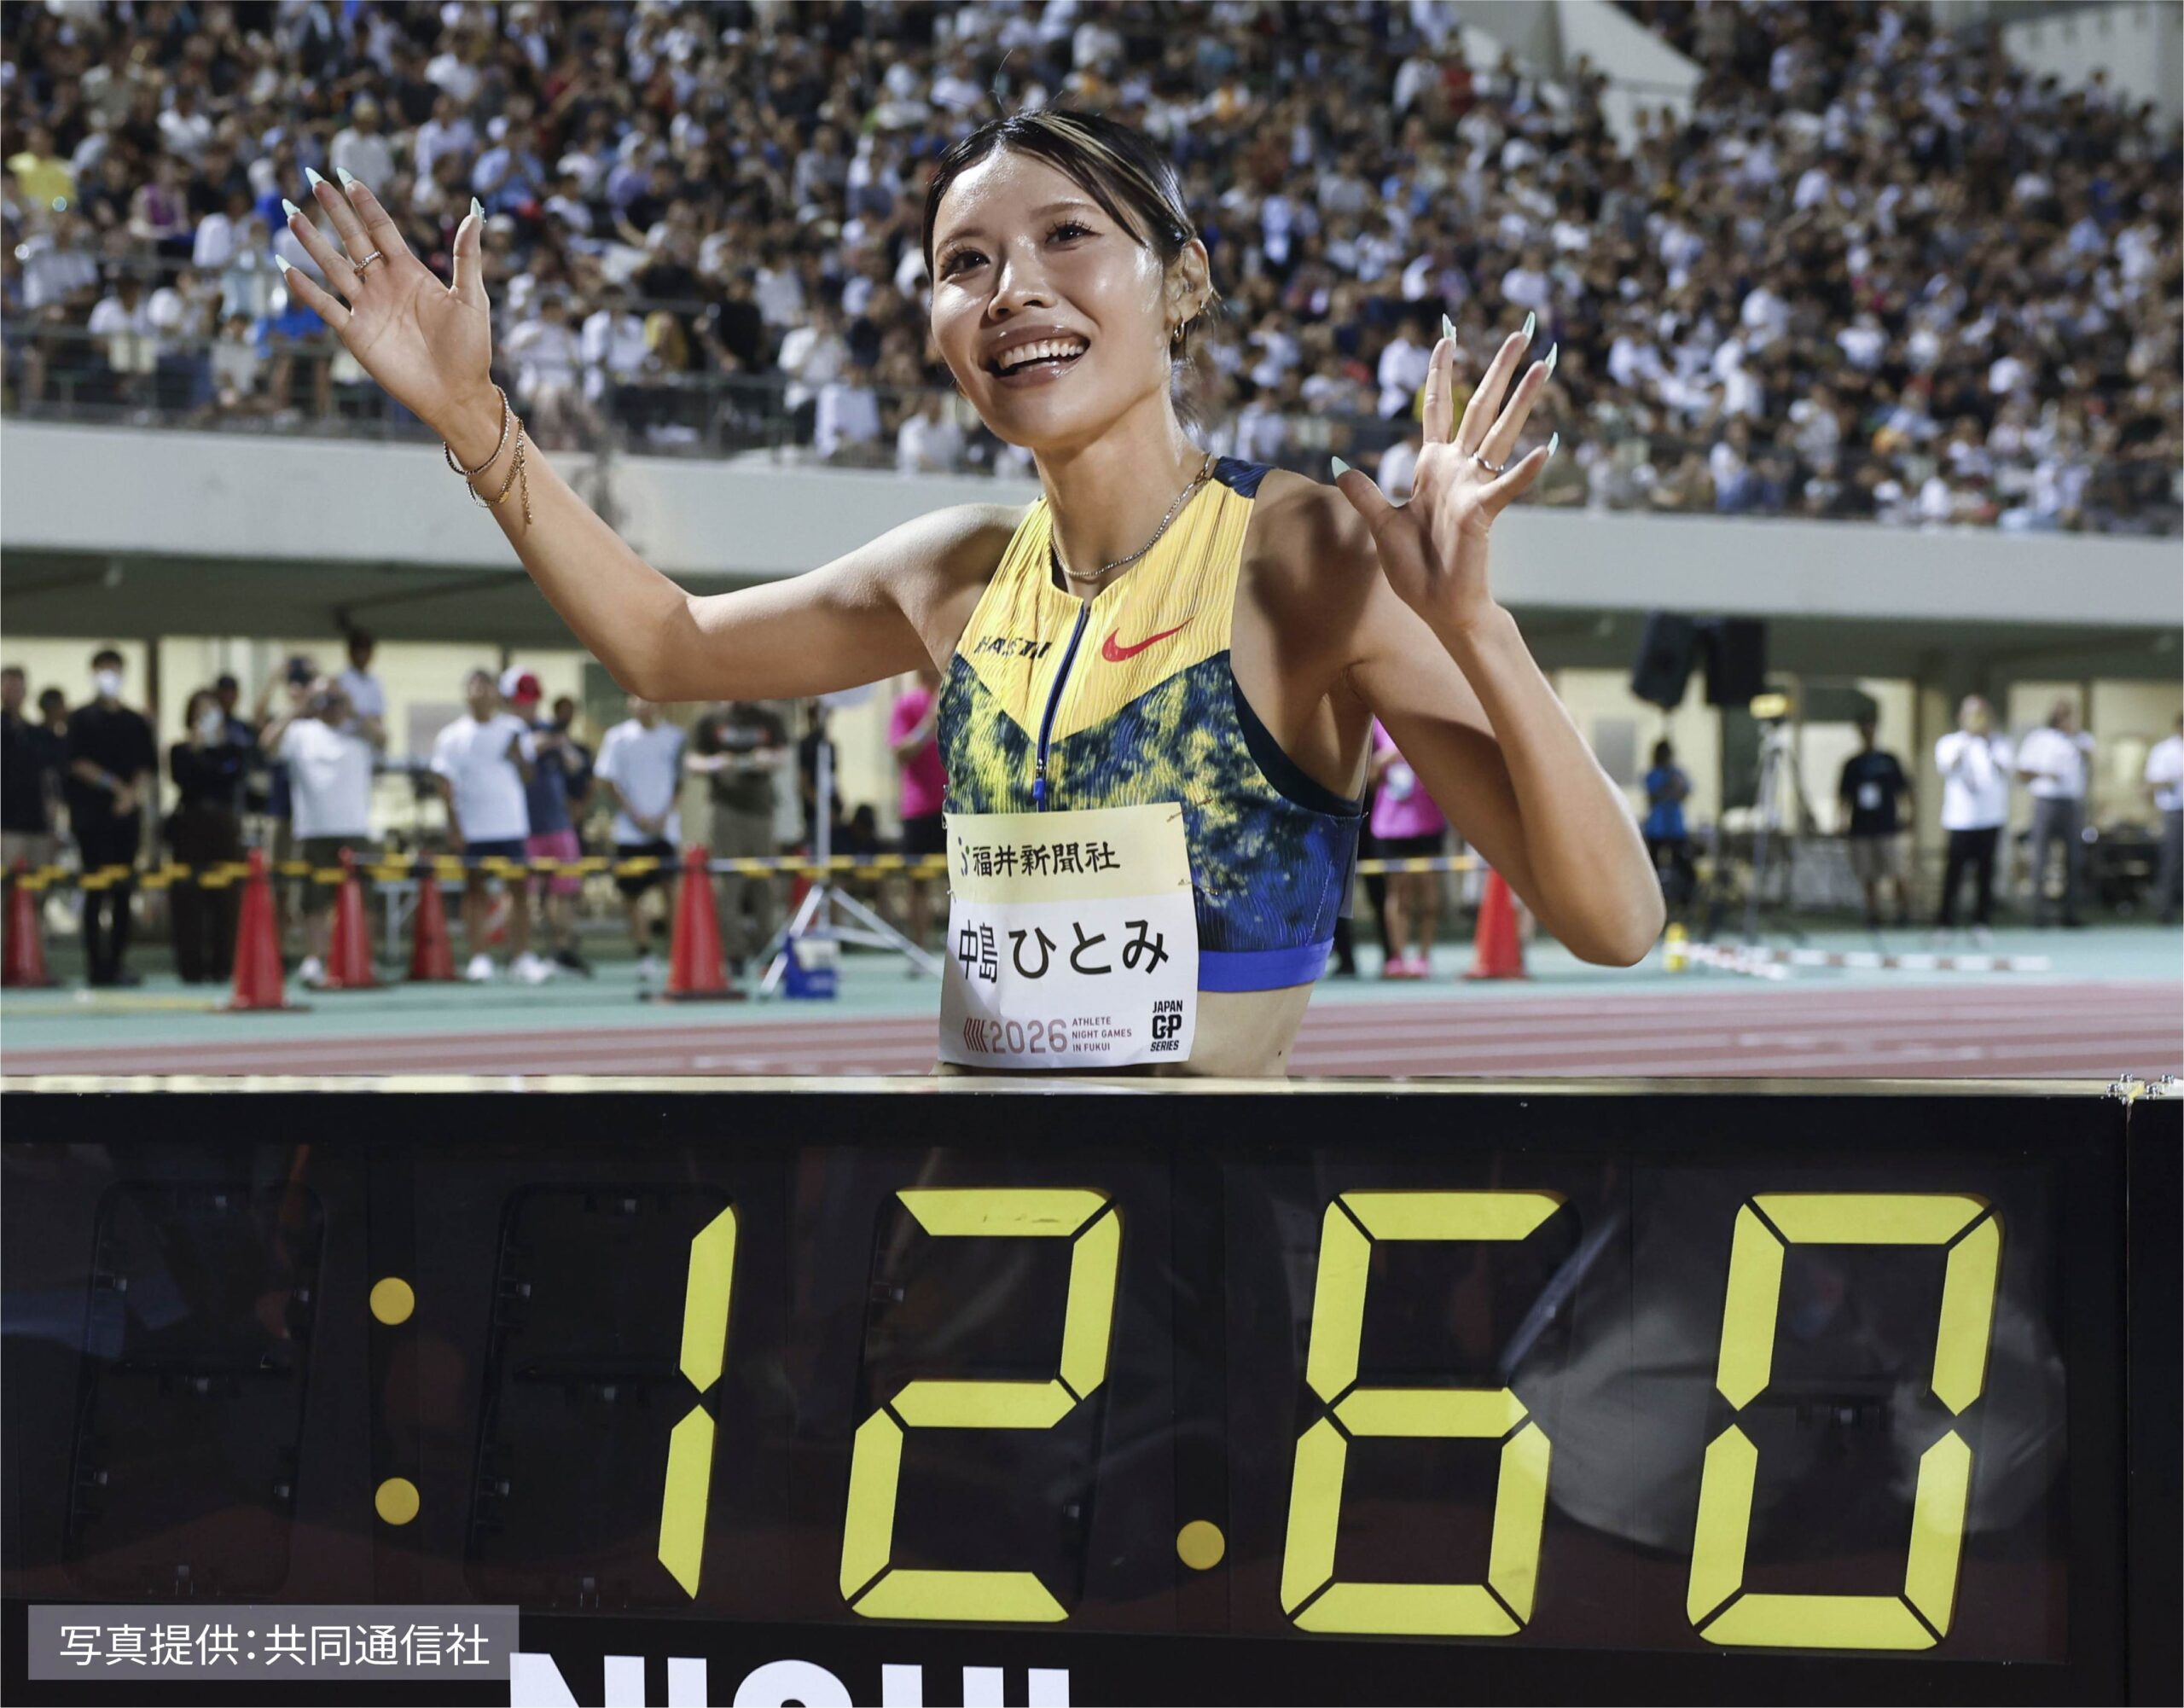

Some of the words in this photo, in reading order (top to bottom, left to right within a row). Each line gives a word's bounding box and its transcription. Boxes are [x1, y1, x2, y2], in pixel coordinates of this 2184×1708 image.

[973, 841, 1121, 877] 福井新聞社
[1153, 1000, 1183, 1013] JAPAN
[1072, 1016, 1112, 1026] ATHLETE
[1152, 1014, 1182, 1039] GP
[990, 1019, 1067, 1054] 2026
[1072, 1030, 1099, 1039] NIGHT
[1101, 1028, 1132, 1038] GAMES
[1072, 1043, 1082, 1052] IN
[1083, 1043, 1111, 1052] FUKUI
[1150, 1040, 1179, 1052] SERIES
